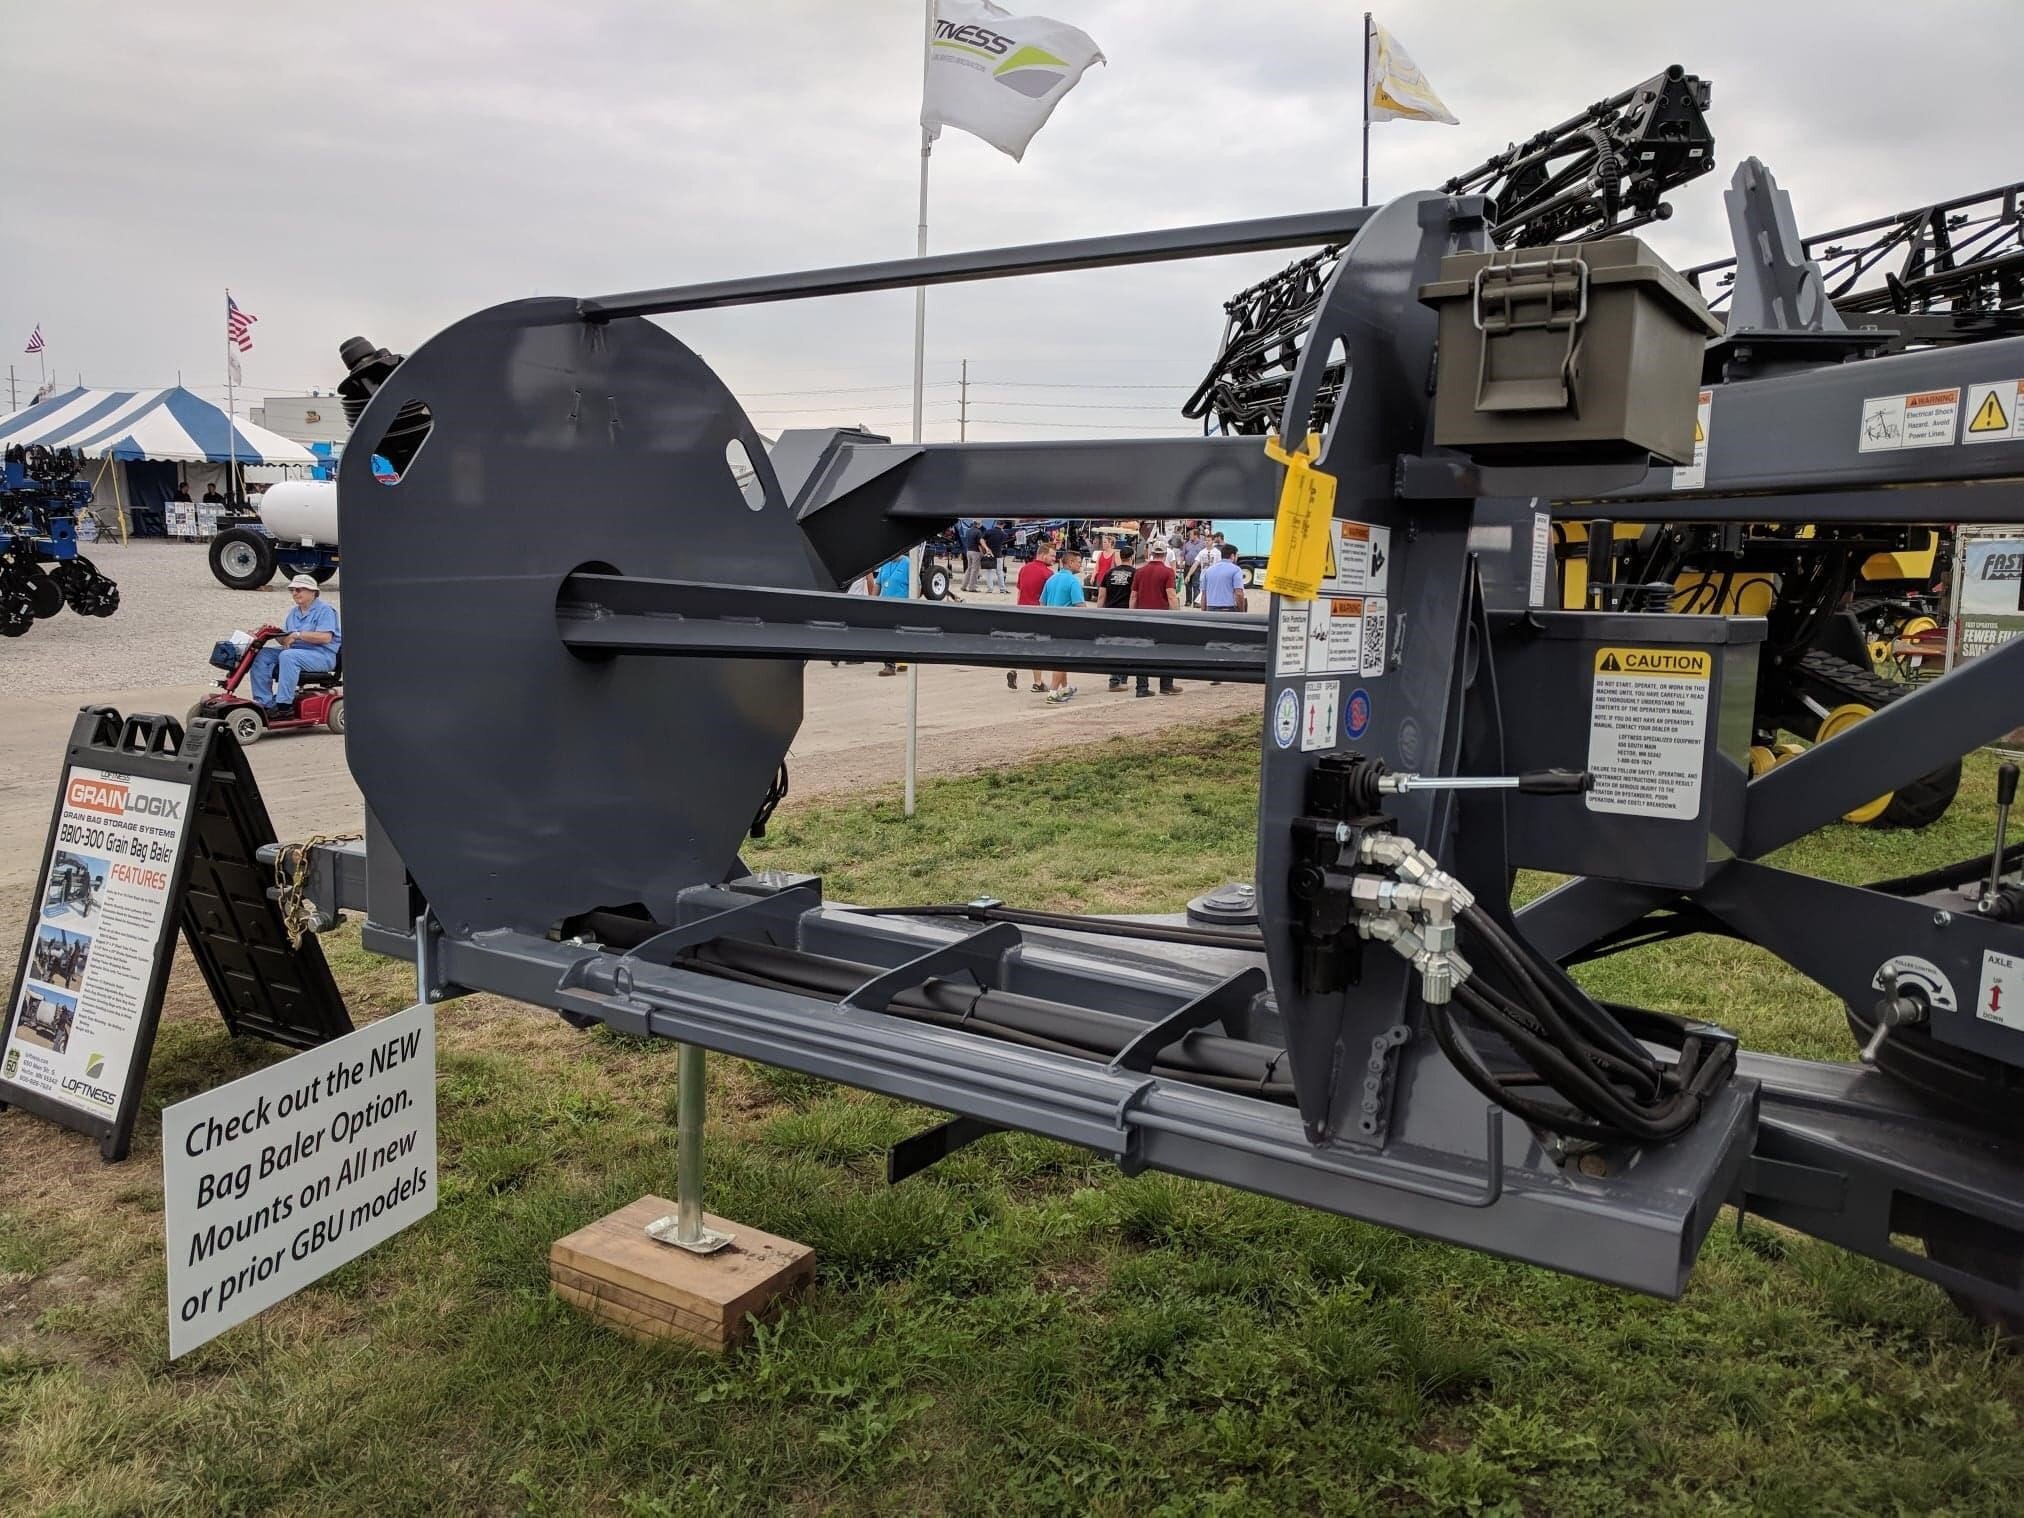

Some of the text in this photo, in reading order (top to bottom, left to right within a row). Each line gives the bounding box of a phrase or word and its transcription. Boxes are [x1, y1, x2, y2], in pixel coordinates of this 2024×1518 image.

[936, 19, 1016, 54] TNESS
[1907, 407, 1953, 418] Electrical Shock
[1918, 394, 1955, 404] WARNING
[1909, 431, 1927, 439] Power
[1963, 629, 2024, 643] FEWER FIL
[1625, 654, 1703, 670] CAUTION
[1623, 776, 1657, 784] INSTRUCTIONS
[64, 811, 175, 838] GRAIN BAG STORAGE SYSTEMS
[106, 832, 128, 855] Grain
[130, 837, 148, 862] Bag
[150, 841, 173, 863] Baler
[111, 863, 168, 890] FEATURES
[1988, 955, 2013, 969] AXLE
[1982, 1011, 2004, 1023] DOWN
[61, 1076, 117, 1105] LOFTNESS
[185, 1028, 422, 1158] Check out the NEW
[196, 1087, 414, 1209] Bag Baler Option.
[188, 1129, 418, 1267] Mounts on All new
[181, 1166, 427, 1322] or prior GBU models
